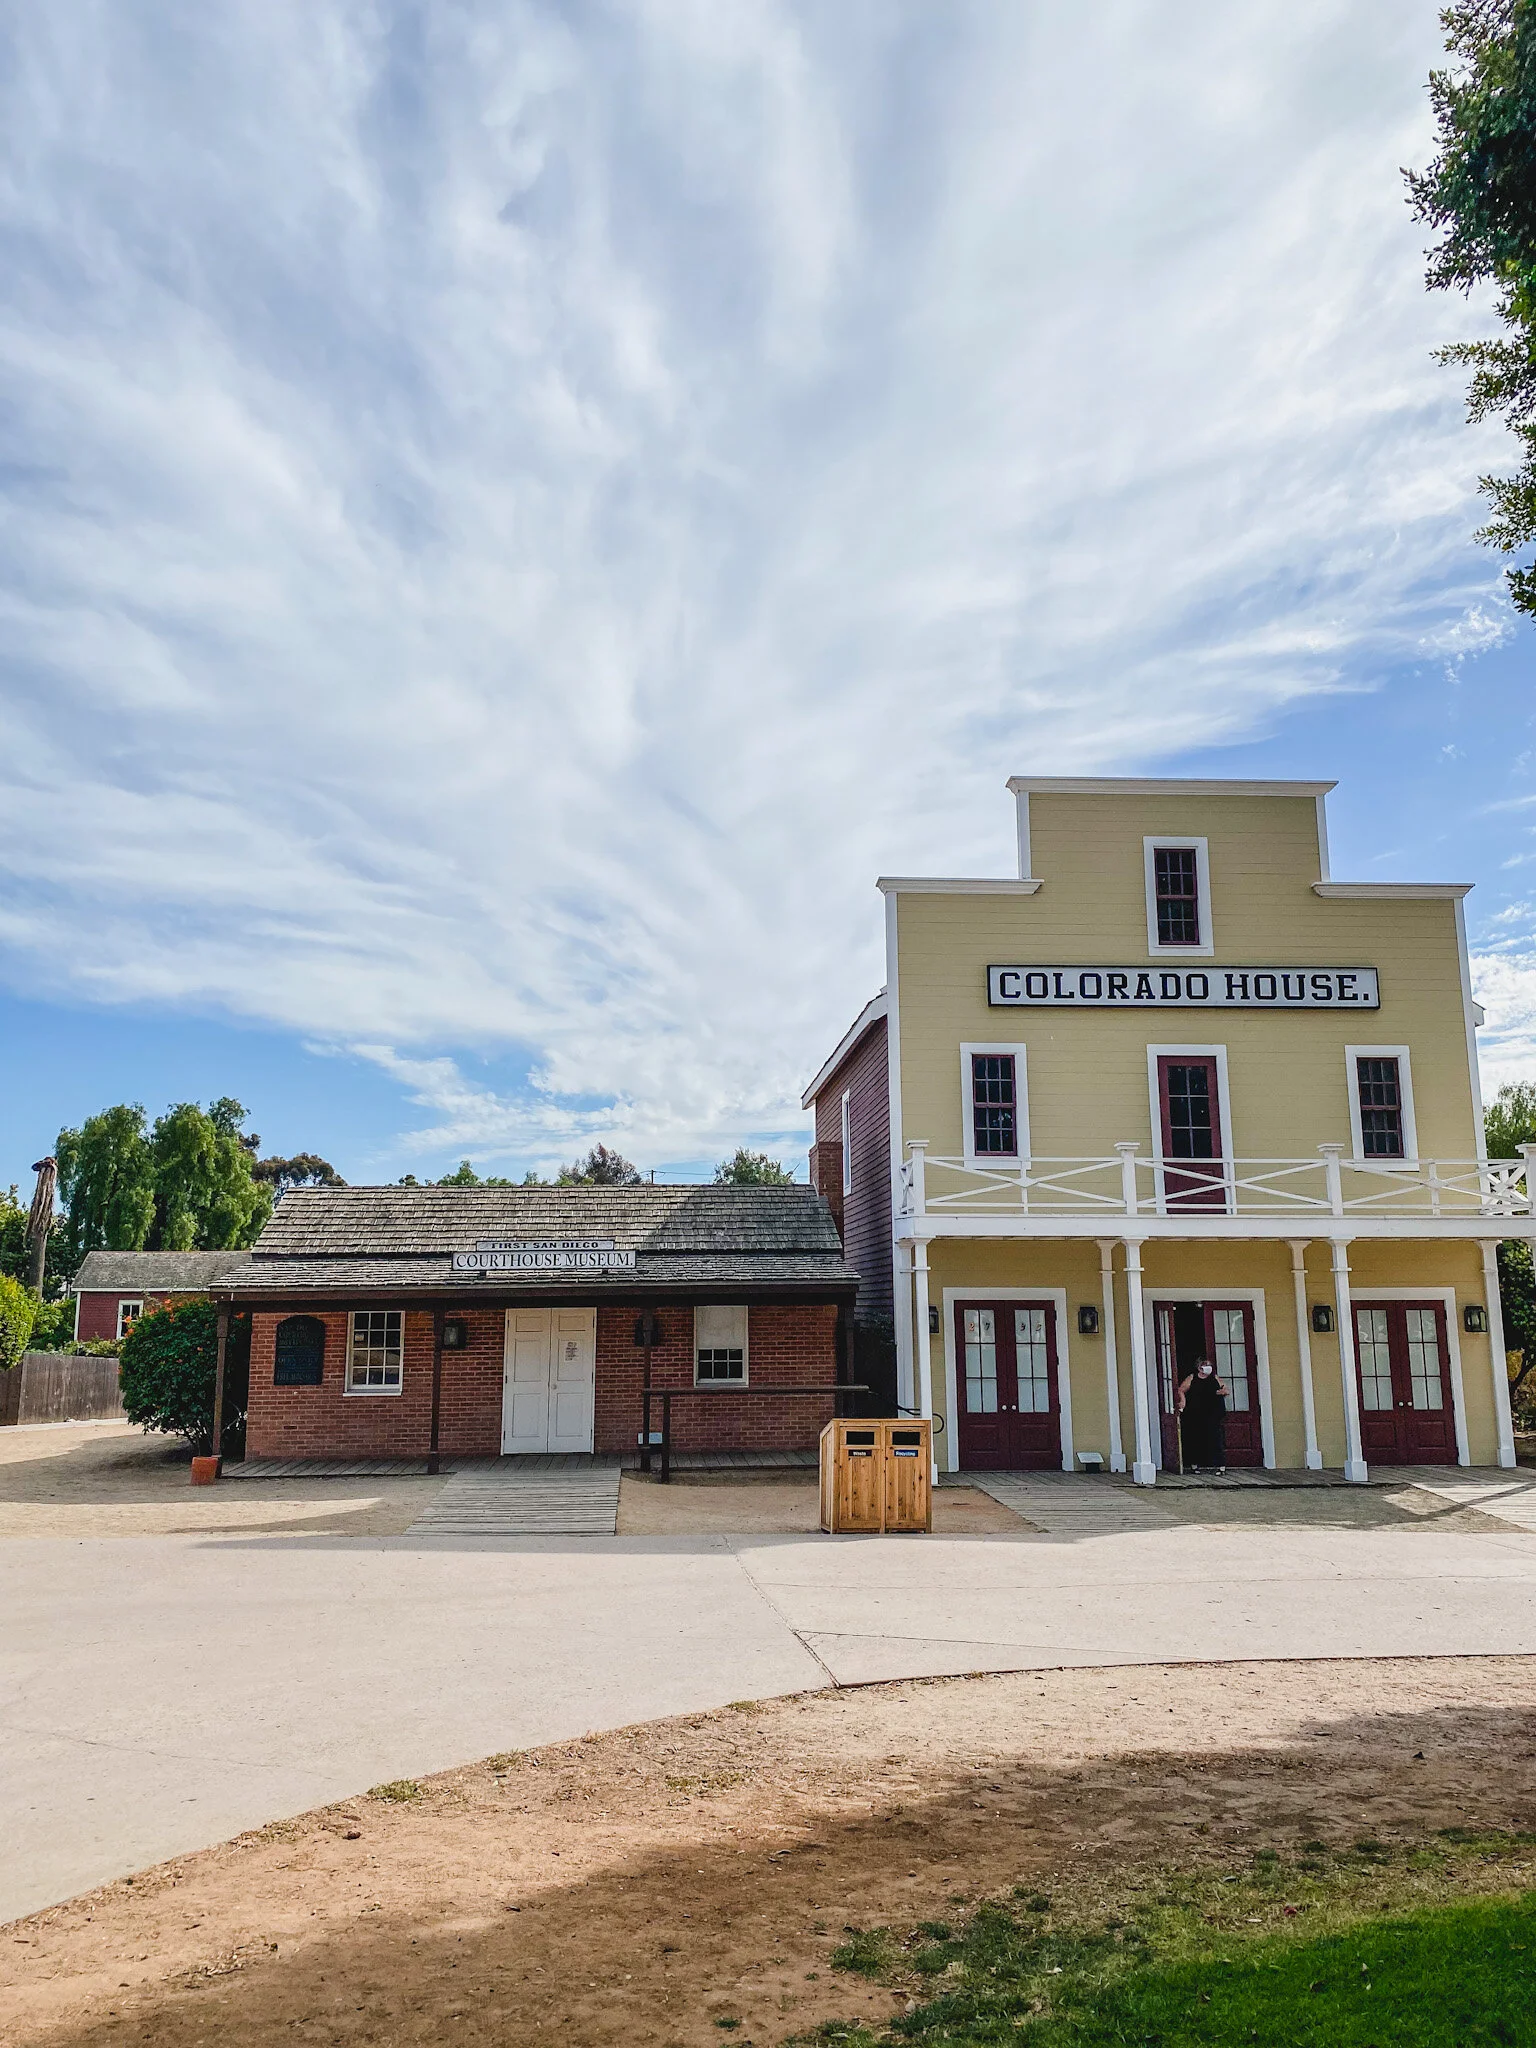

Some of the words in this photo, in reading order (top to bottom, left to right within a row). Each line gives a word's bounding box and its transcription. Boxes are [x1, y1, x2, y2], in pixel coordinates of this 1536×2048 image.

[999, 972, 1209, 1000] COLORADO
[1224, 973, 1370, 1001] HOUSE.
[562, 1241, 599, 1249] DIEGO
[456, 1252, 562, 1268] COURTHOUSE
[565, 1252, 633, 1267] MUSEUM.
